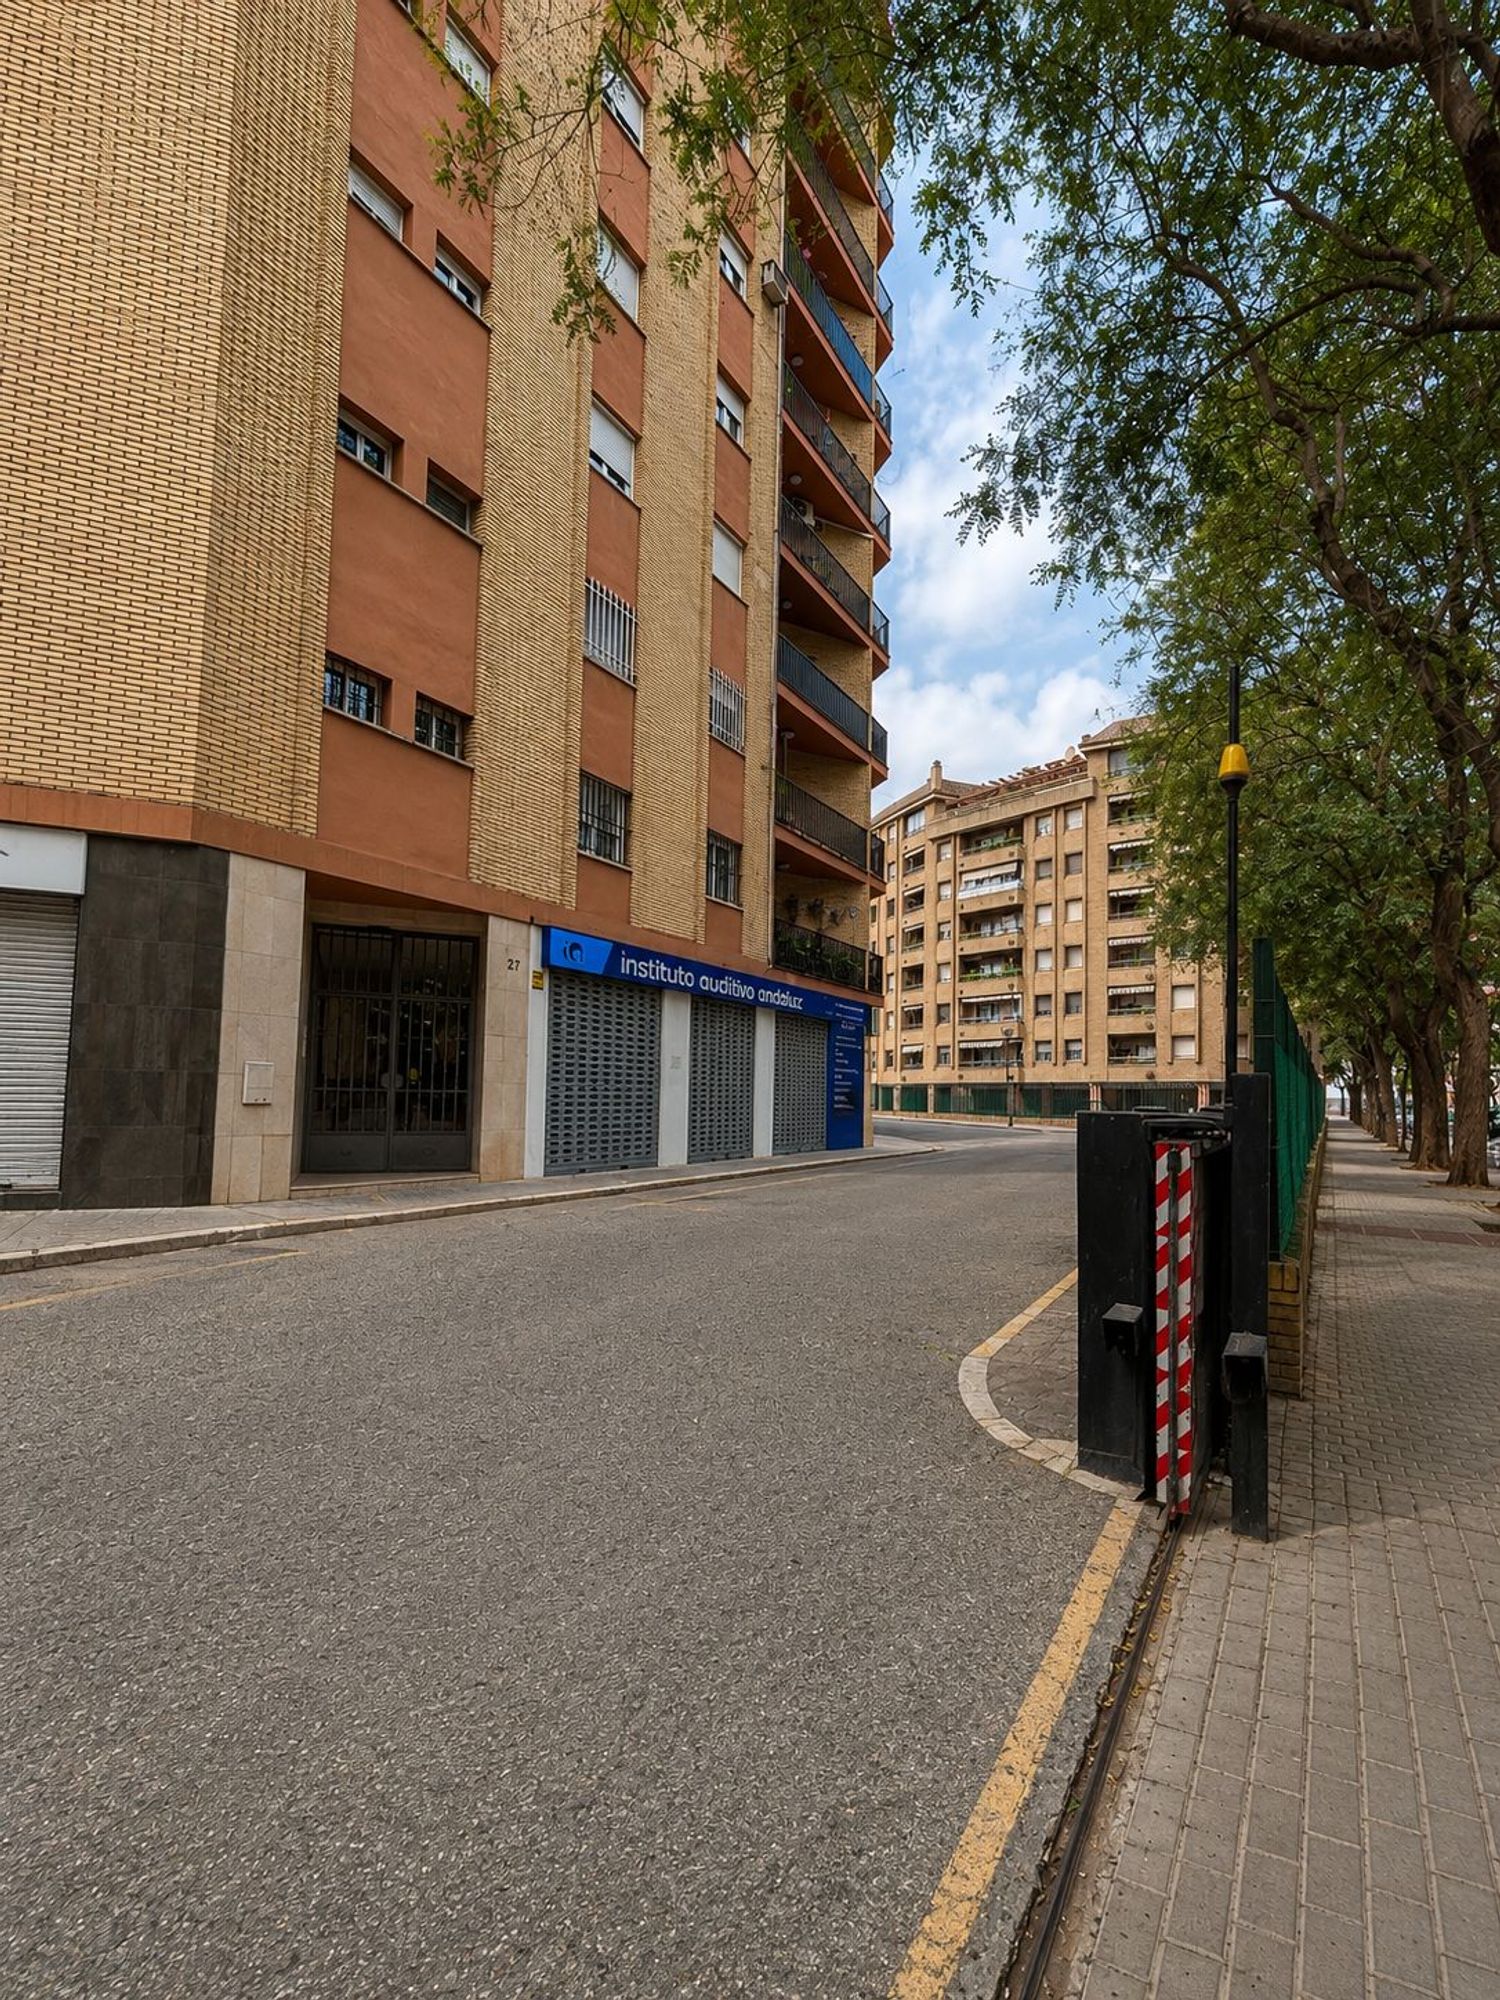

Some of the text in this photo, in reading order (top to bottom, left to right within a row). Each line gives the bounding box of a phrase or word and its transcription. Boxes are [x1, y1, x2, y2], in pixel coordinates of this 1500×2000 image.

[507, 958, 520, 971] 27
[620, 951, 695, 987] instituto
[699, 976, 755, 1000] auditivo
